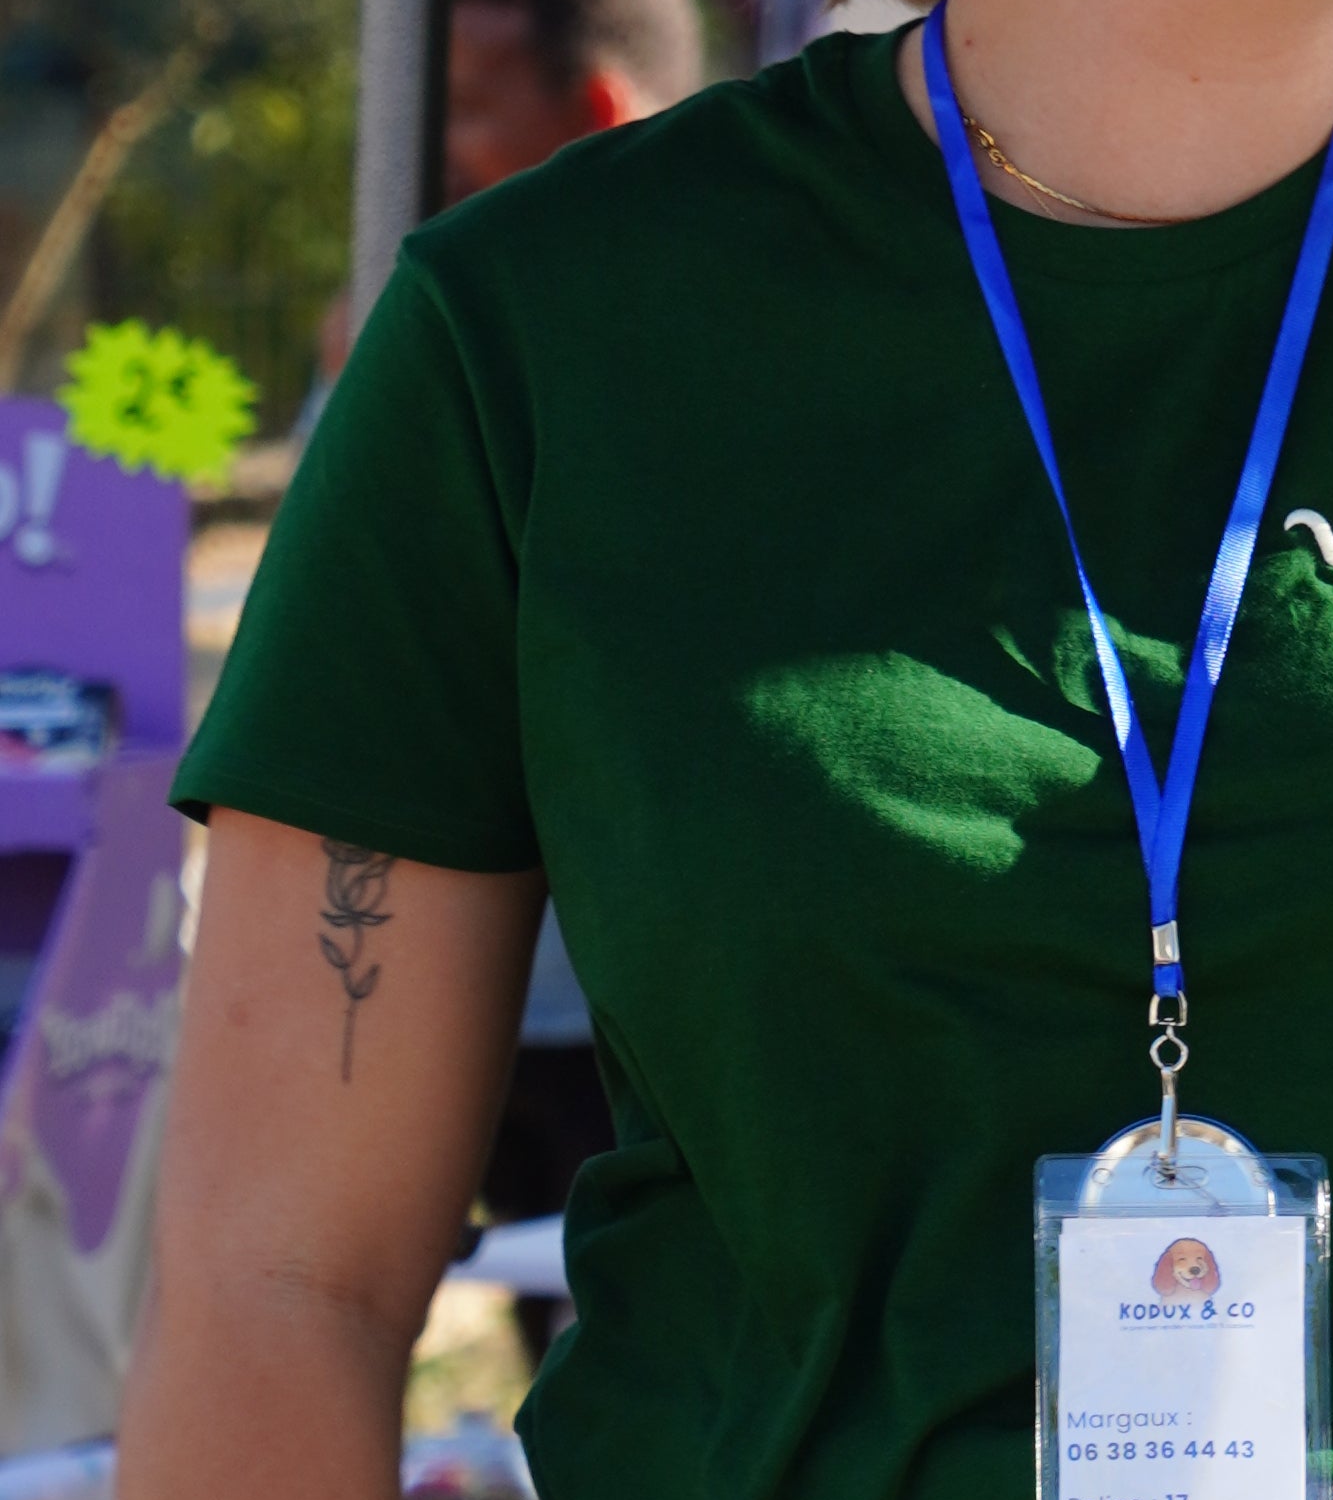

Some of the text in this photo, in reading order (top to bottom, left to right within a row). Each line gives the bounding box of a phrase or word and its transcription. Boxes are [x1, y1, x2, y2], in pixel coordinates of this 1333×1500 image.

[1119, 1300, 1255, 1320] KODUX & CO
[1067, 1410, 1178, 1433] Margaux
[1068, 1441, 1255, 1461] 06 38 36 44 43
